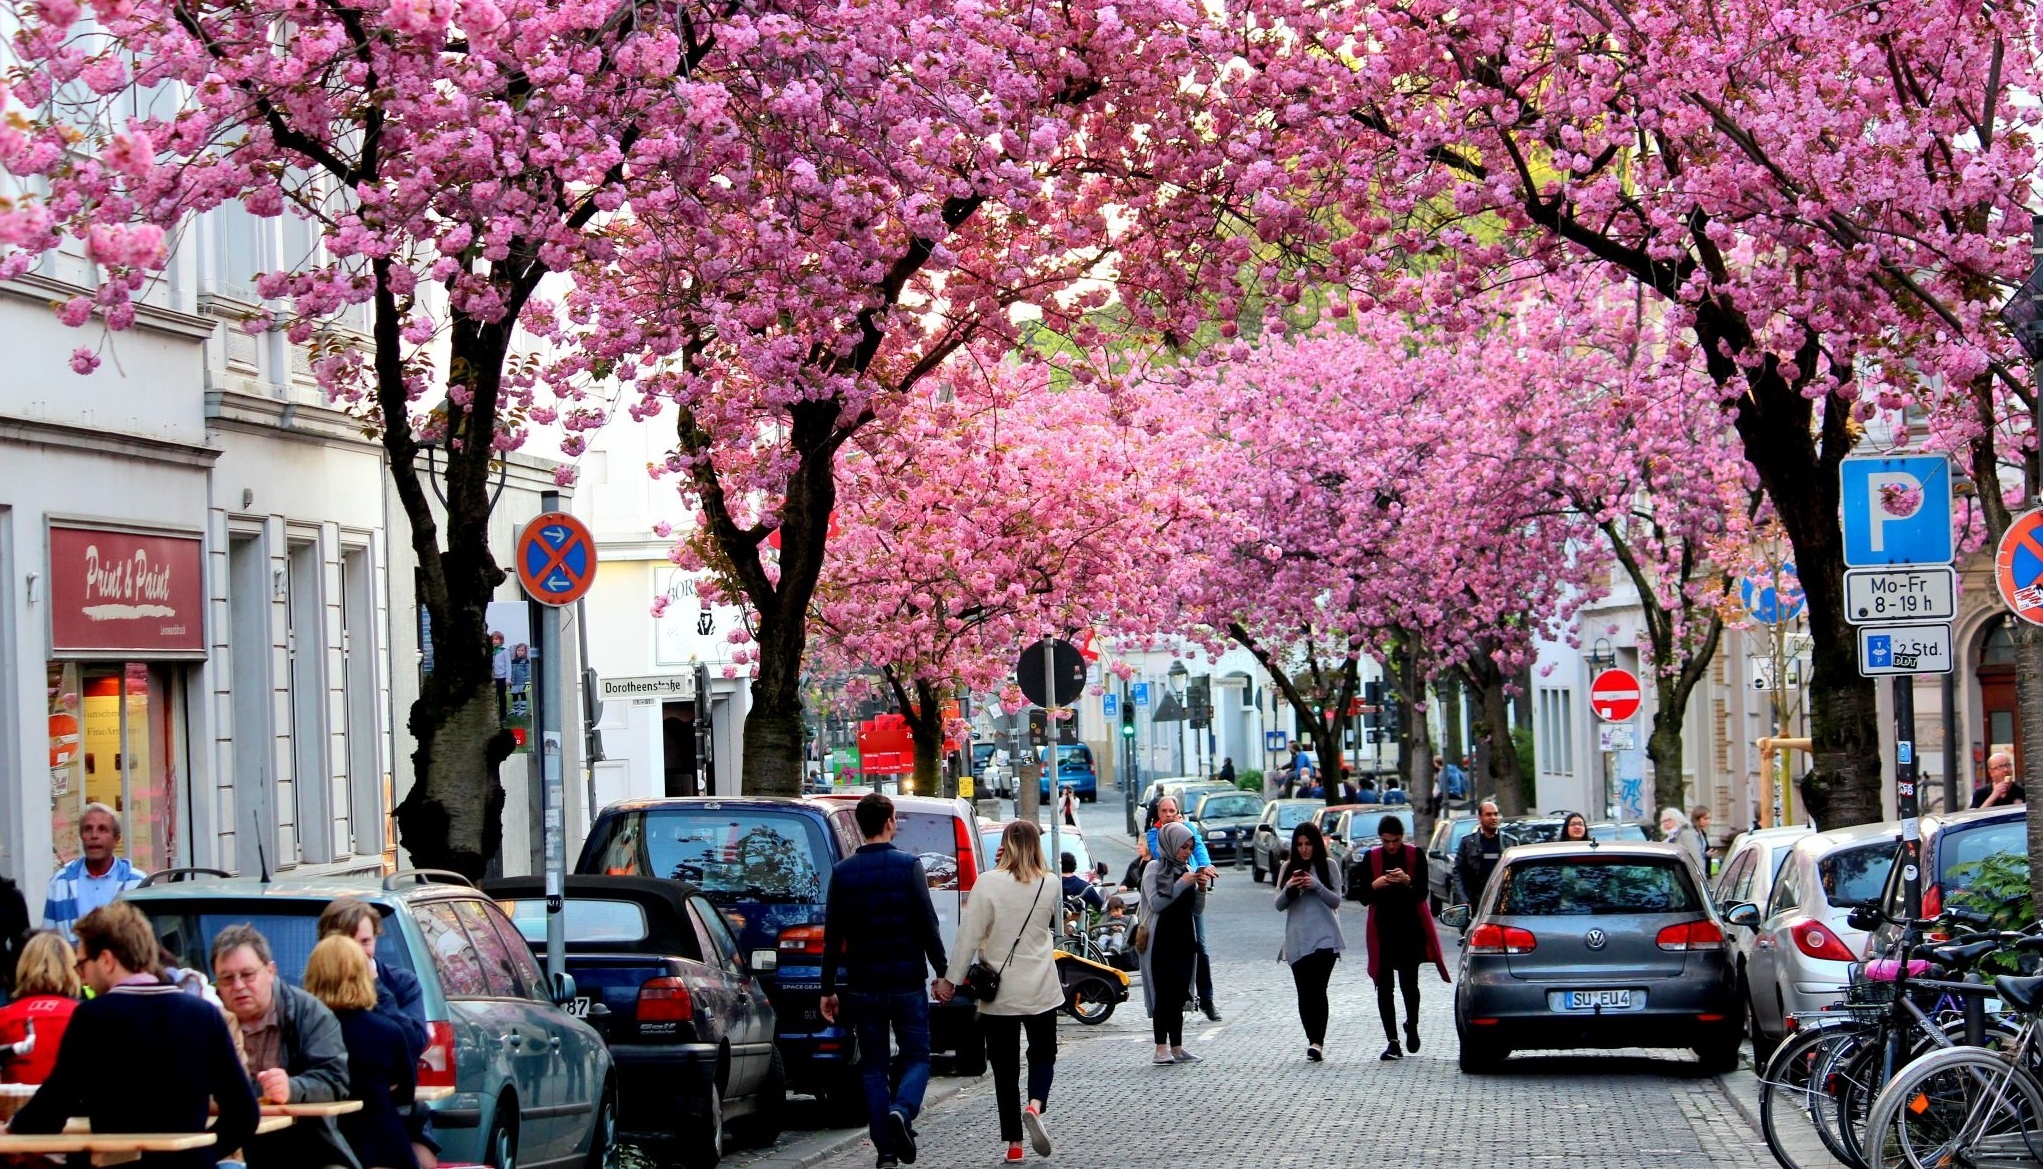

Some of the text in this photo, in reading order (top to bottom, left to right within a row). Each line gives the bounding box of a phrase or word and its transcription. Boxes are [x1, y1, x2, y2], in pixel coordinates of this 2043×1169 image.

[1868, 472, 1924, 552] P
[86, 545, 170, 601] Print & Paint
[1871, 576, 1927, 594] Mo-Fr
[1924, 595, 1932, 611] h
[1899, 642, 1942, 656] 2 Std.
[1894, 655, 1916, 668] DDT
[1574, 993, 1591, 1006] SU
